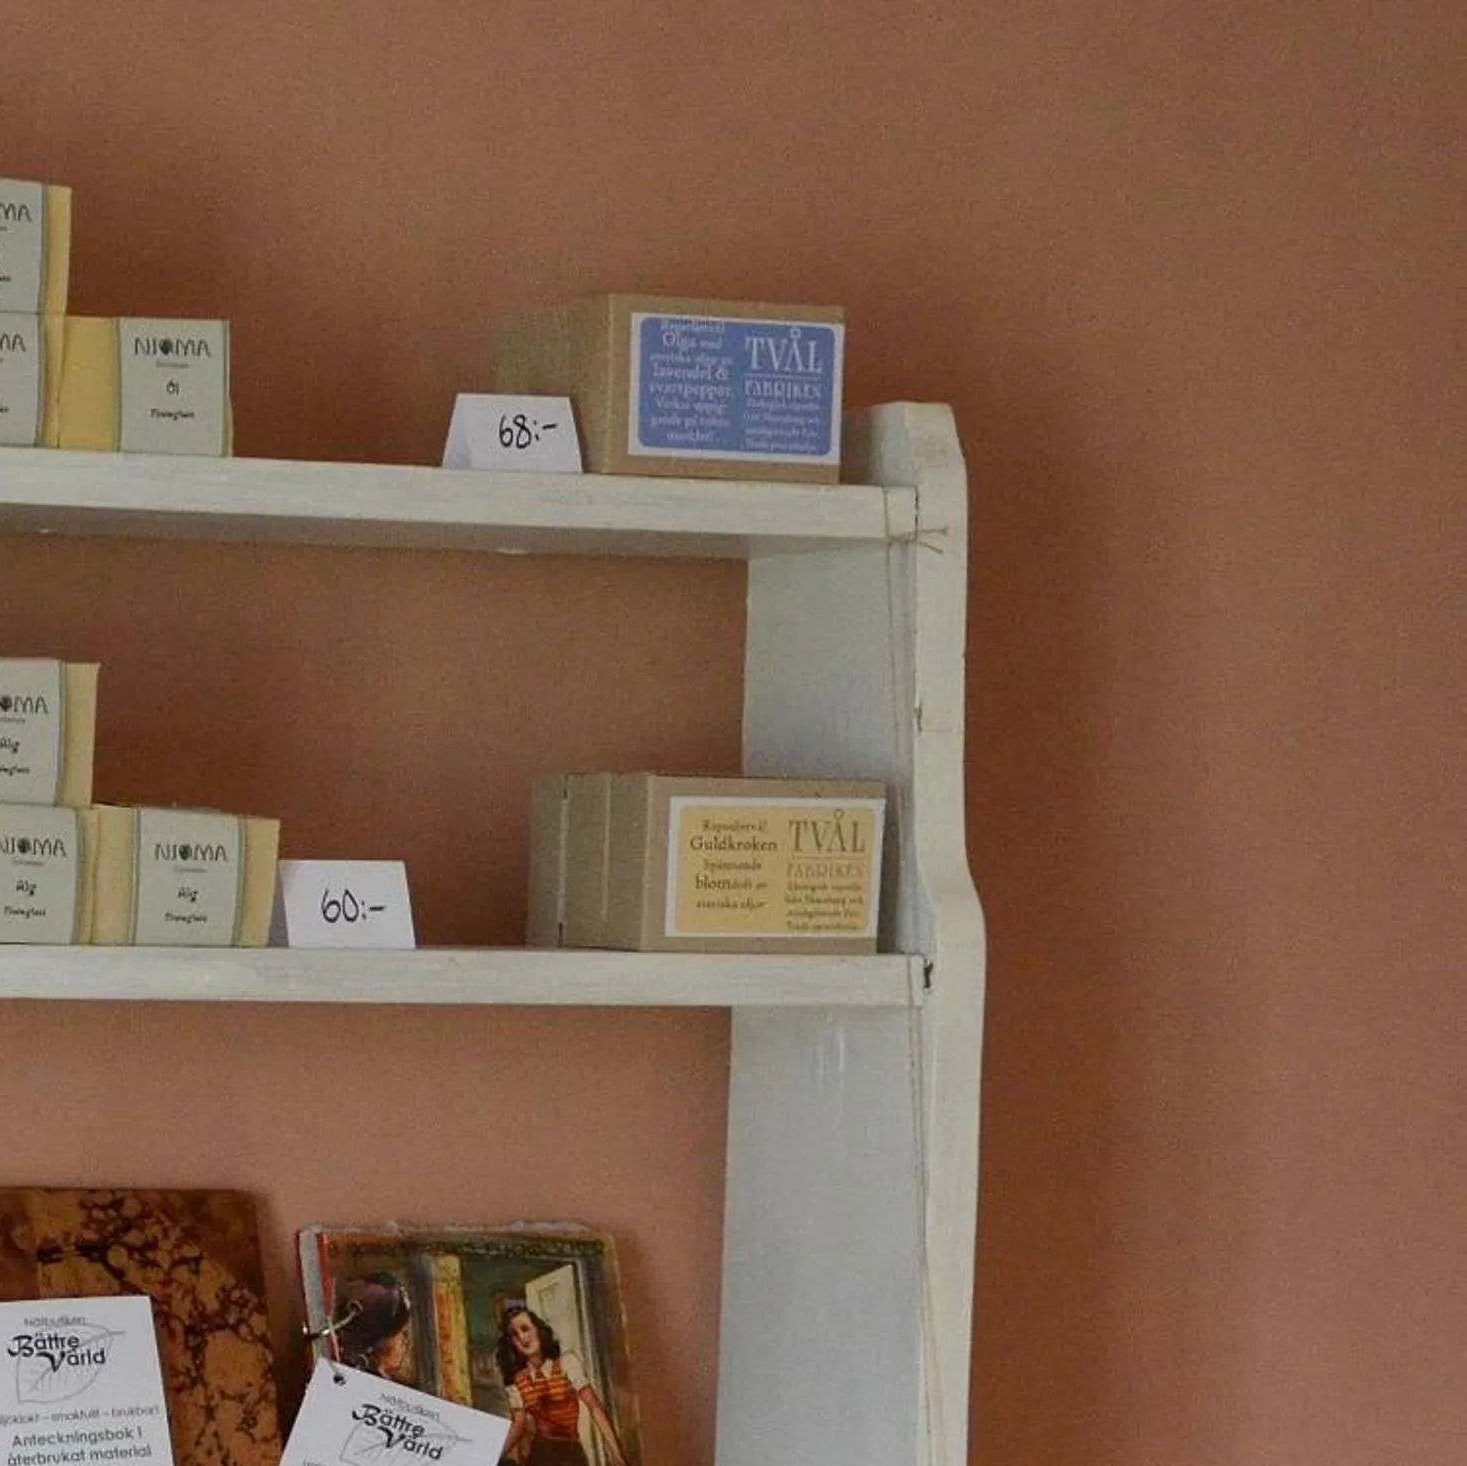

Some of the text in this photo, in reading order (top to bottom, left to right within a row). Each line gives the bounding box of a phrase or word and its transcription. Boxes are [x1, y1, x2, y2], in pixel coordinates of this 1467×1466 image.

[134, 336, 212, 359] NIOMA
[745, 328, 823, 374] TVÅL
[654, 364, 711, 380] lavendel
[498, 413, 559, 449] 68:-
[690, 835, 777, 851] Guldkroken
[789, 809, 865, 853] TVÅL
[154, 842, 228, 863] NIOMA
[321, 888, 386, 925] 60:-
[7, 1331, 80, 1357] Bättre
[36, 1347, 106, 1373] Värld
[351, 1403, 426, 1438] Bättre
[11, 1429, 134, 1450] Anteckningsbok
[377, 1426, 444, 1461] Värld
[90, 1445, 153, 1462] material
